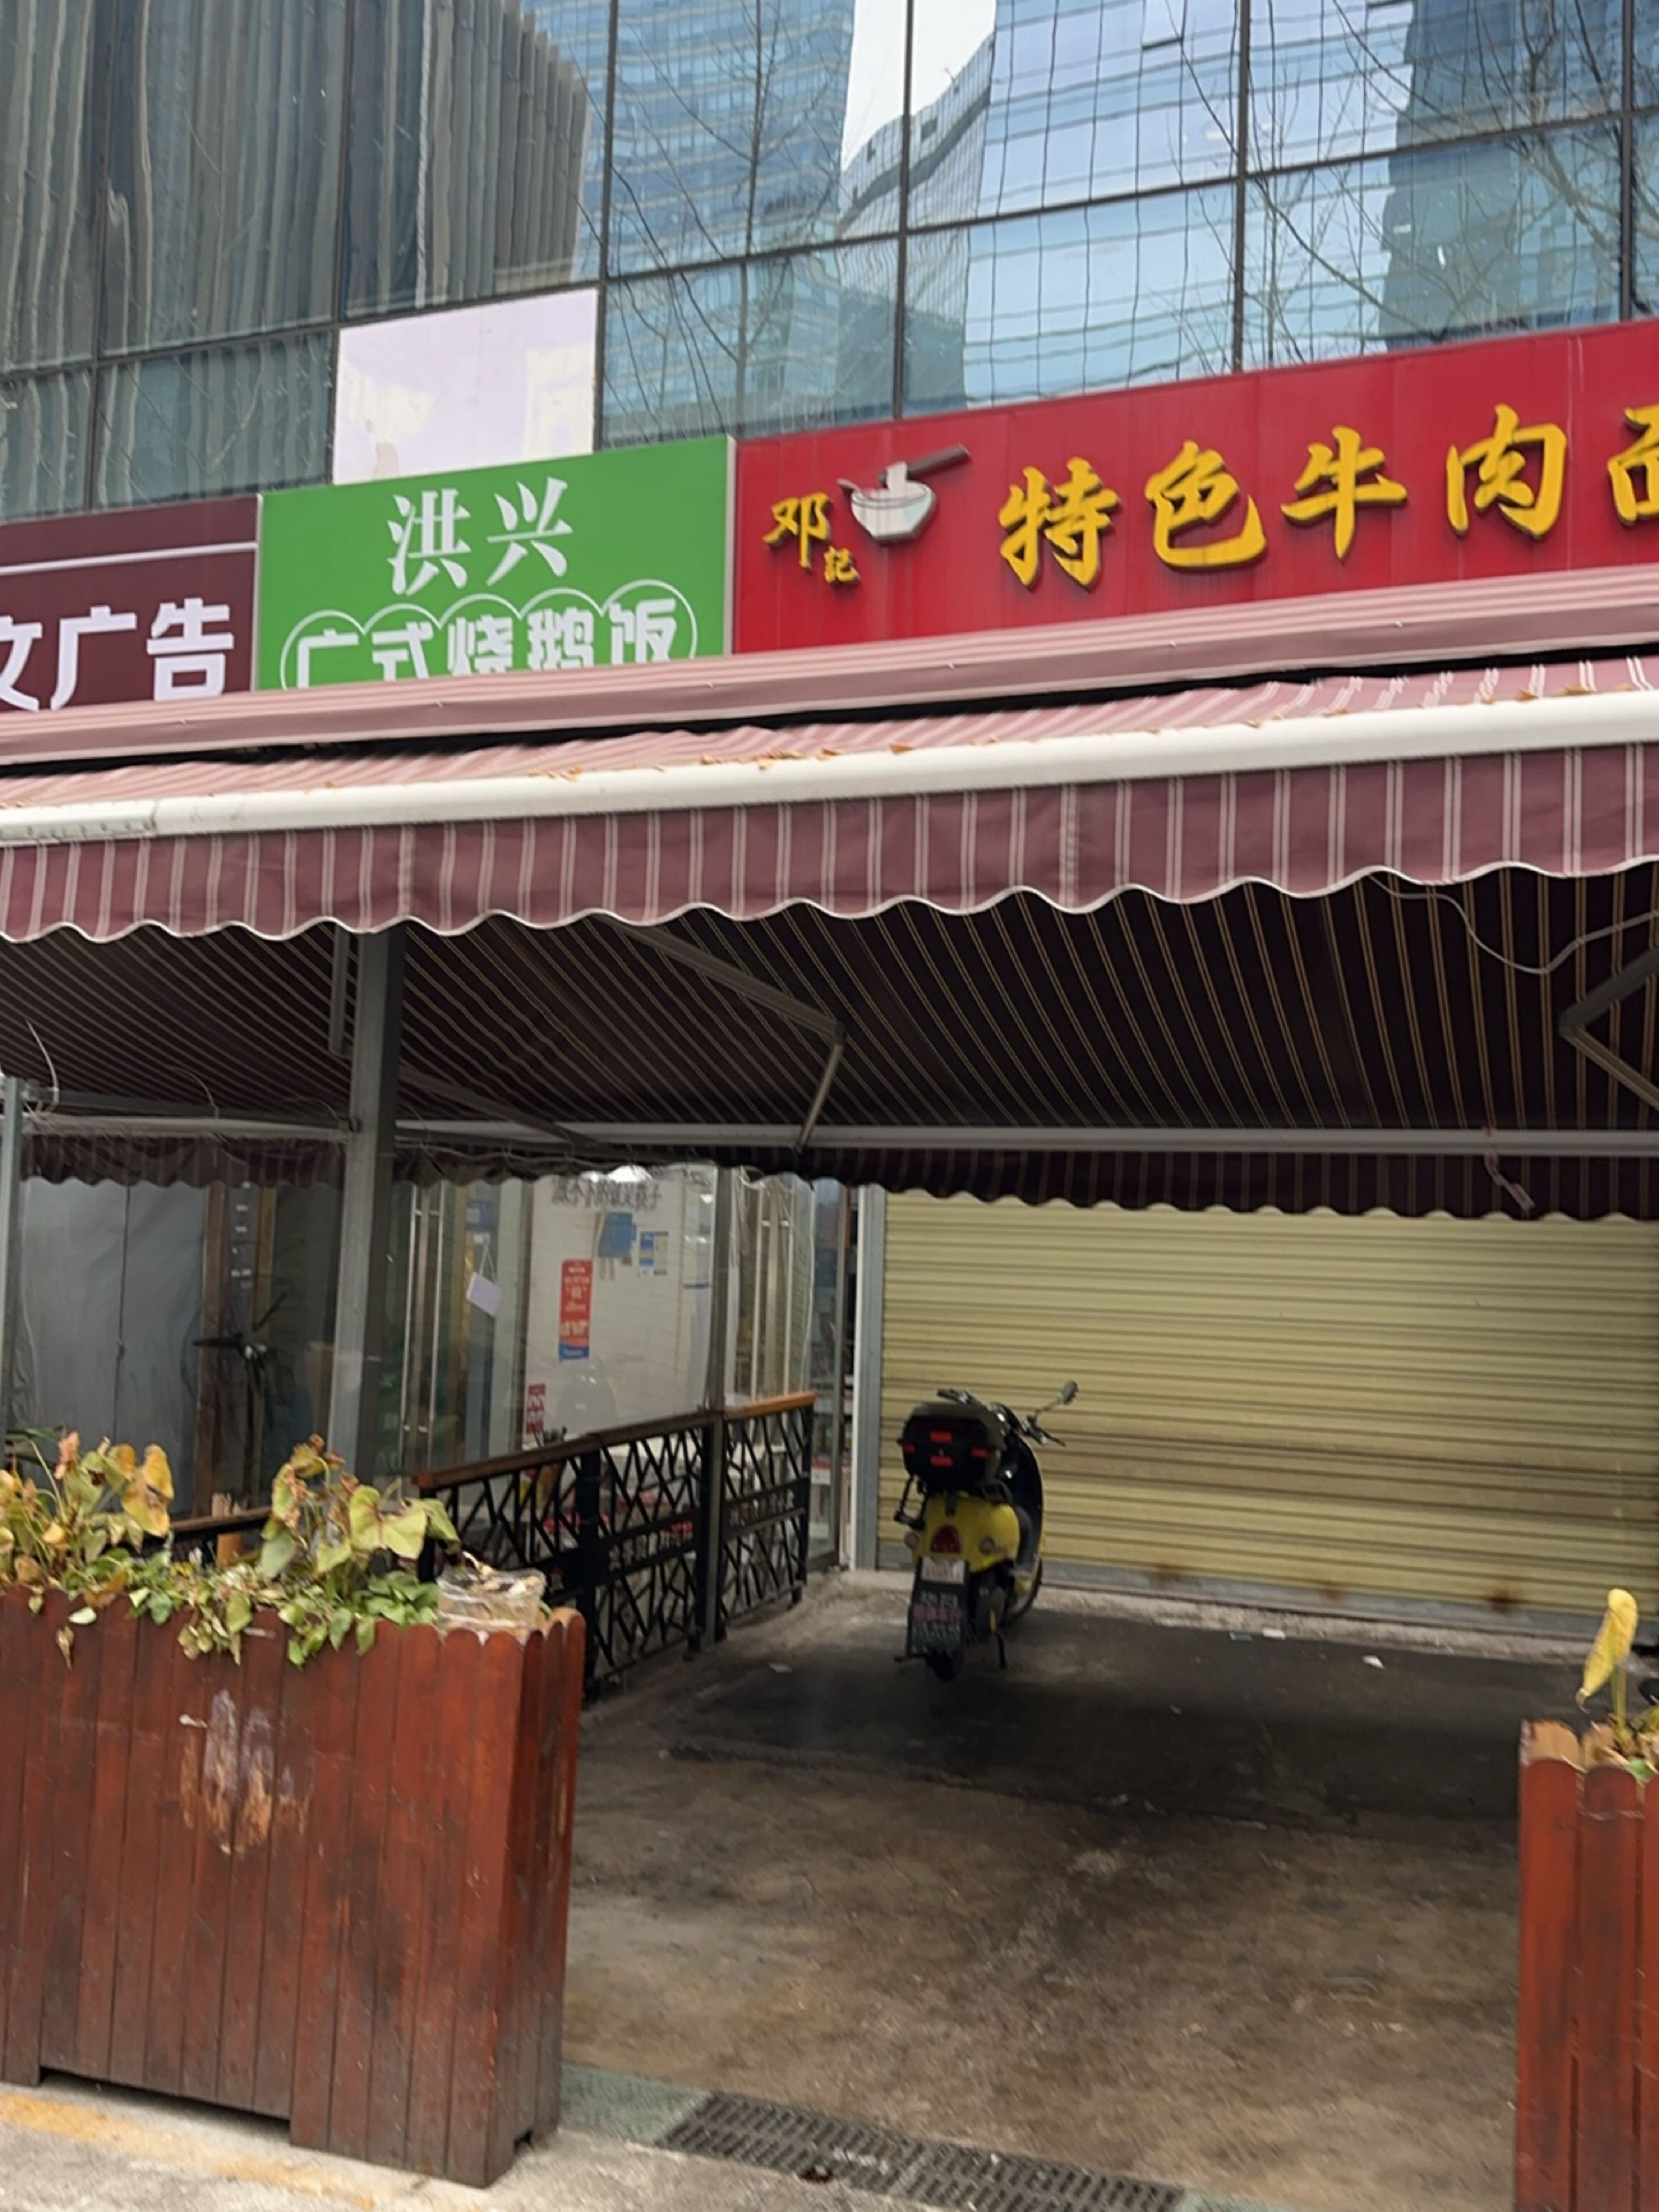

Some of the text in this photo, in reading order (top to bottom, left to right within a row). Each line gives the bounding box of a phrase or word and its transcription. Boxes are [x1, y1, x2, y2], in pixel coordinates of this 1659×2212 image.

[387, 477, 573, 597] 洪兴
[763, 492, 860, 583] 邓记
[296, 598, 677, 688] 广式烧鹅饭
